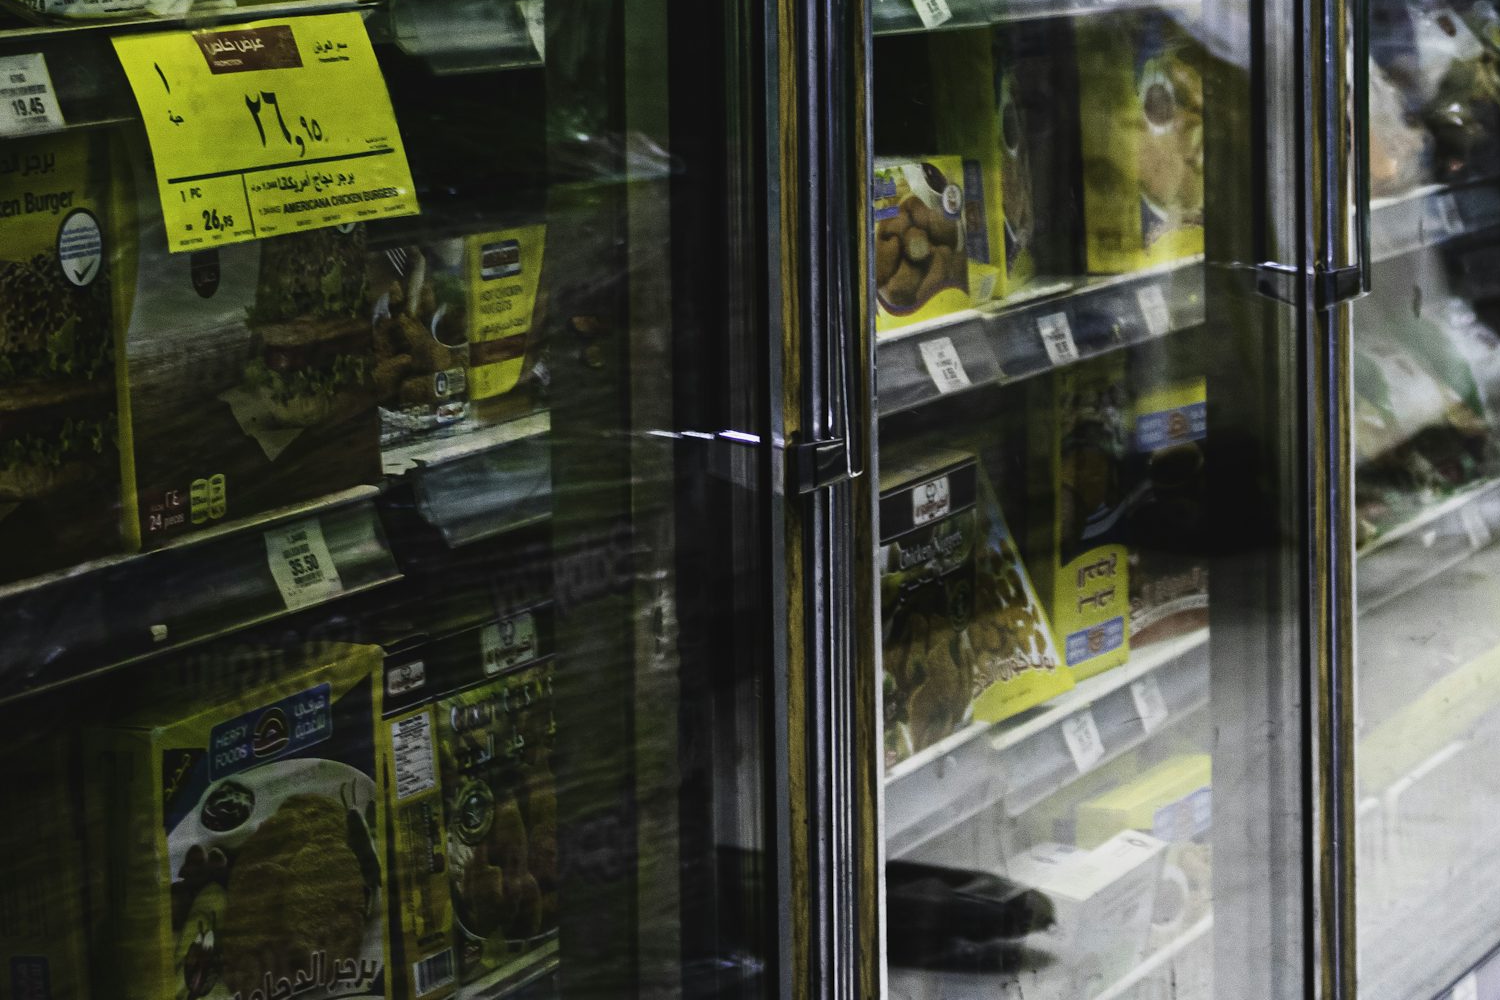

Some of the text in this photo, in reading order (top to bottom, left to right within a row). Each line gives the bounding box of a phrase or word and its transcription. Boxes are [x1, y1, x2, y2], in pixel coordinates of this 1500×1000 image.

[203, 38, 265, 56] عرض خاص
[12, 97, 46, 116] 19.45
[190, 187, 203, 199] PC
[283, 186, 400, 214] AMERICANA CHICKEN BURGERS
[24, 191, 75, 215] Burger
[149, 512, 162, 531] 24
[215, 742, 249, 770] FOODS
